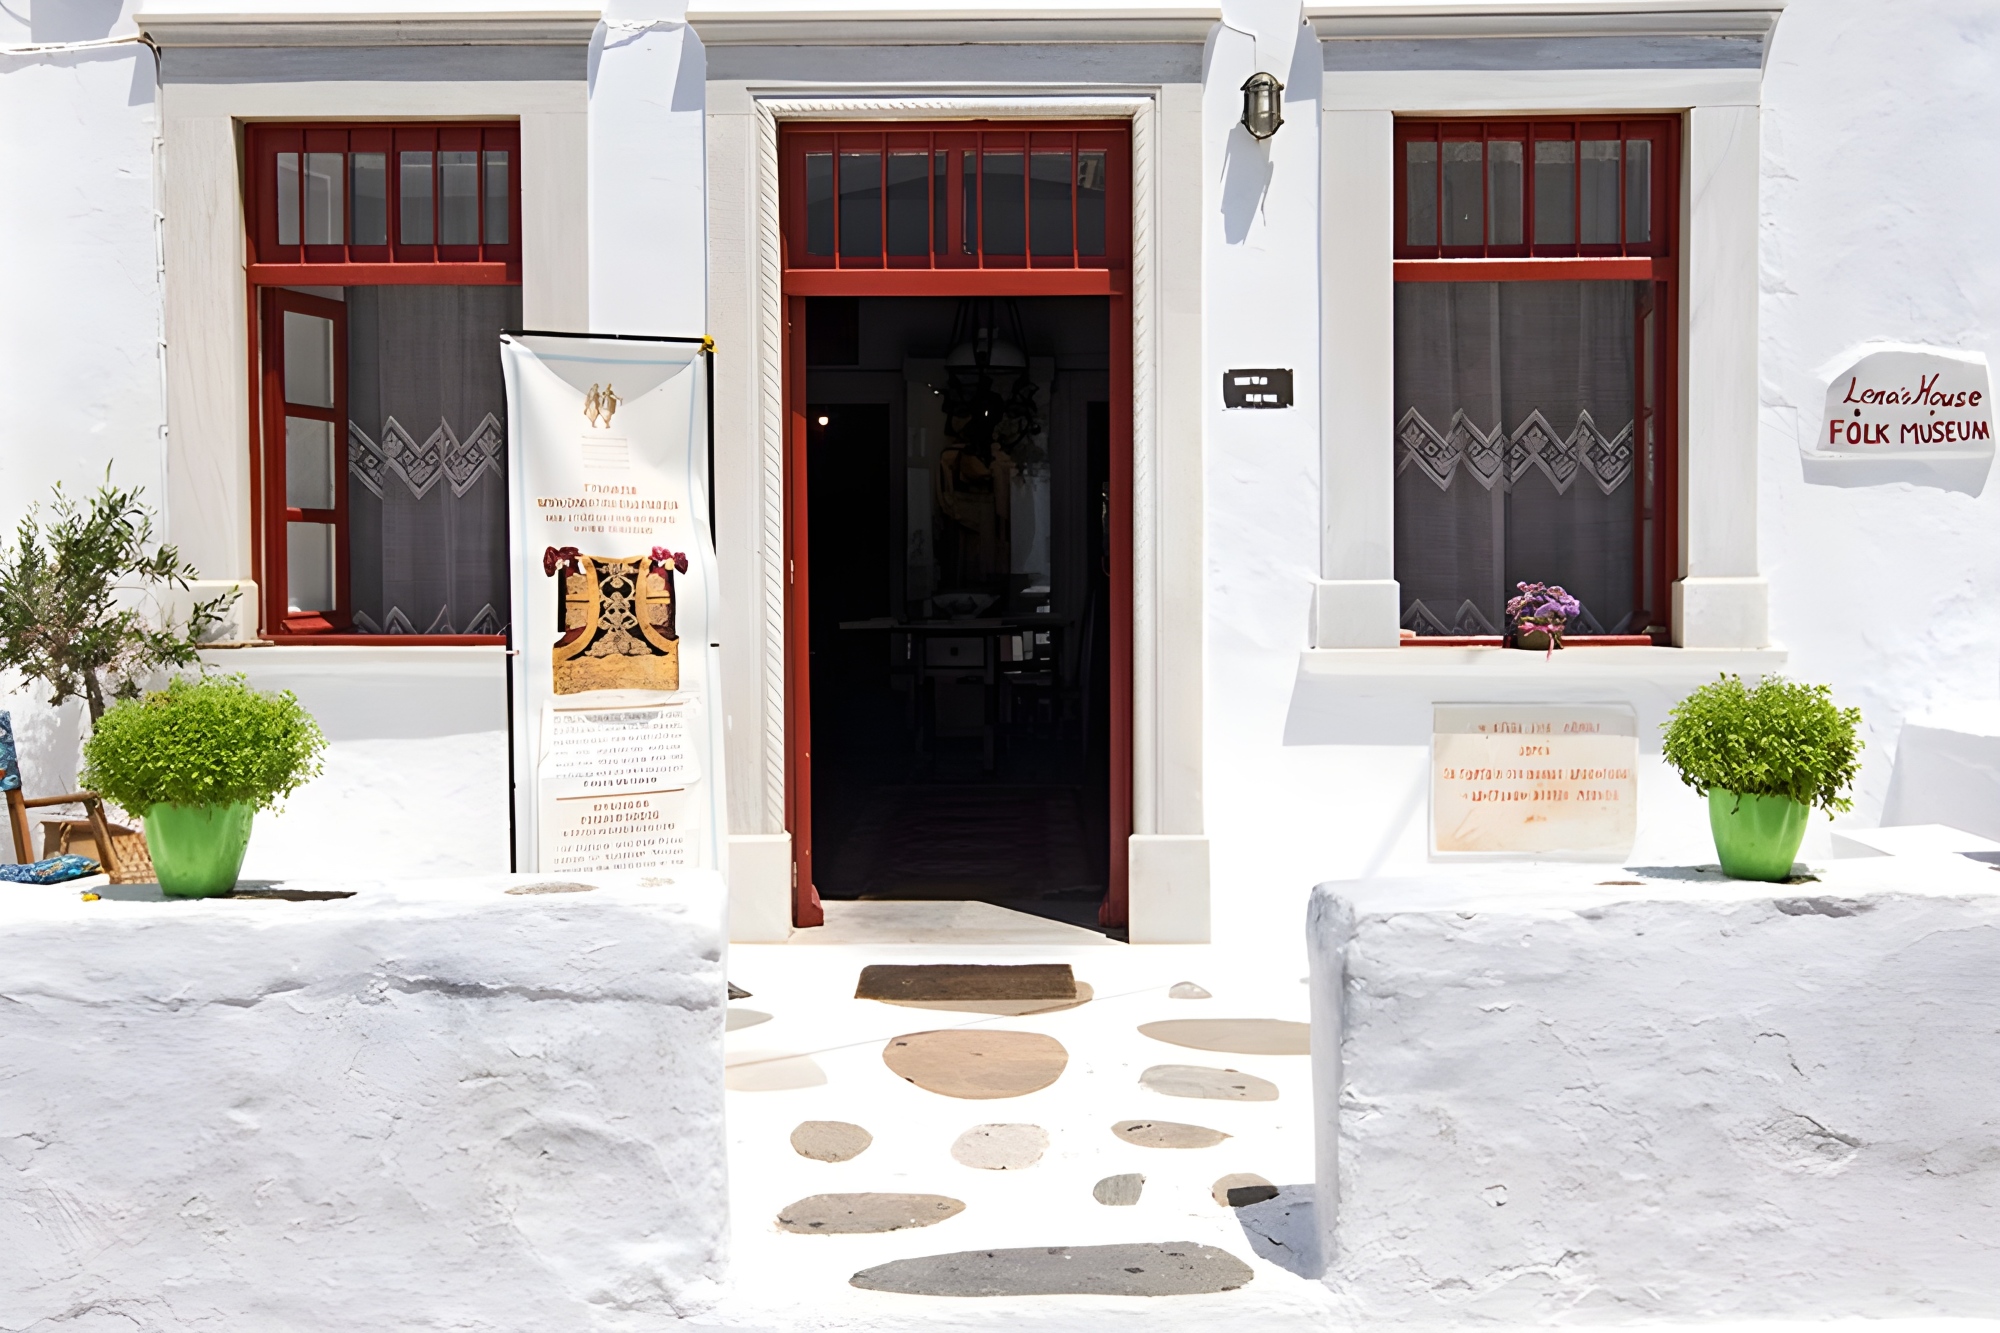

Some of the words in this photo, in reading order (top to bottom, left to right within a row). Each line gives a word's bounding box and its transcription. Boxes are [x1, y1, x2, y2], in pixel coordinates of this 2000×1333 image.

[1911, 373, 1982, 407] House
[1829, 419, 1890, 444] FOLK
[1900, 420, 1990, 444] MUSEUM
